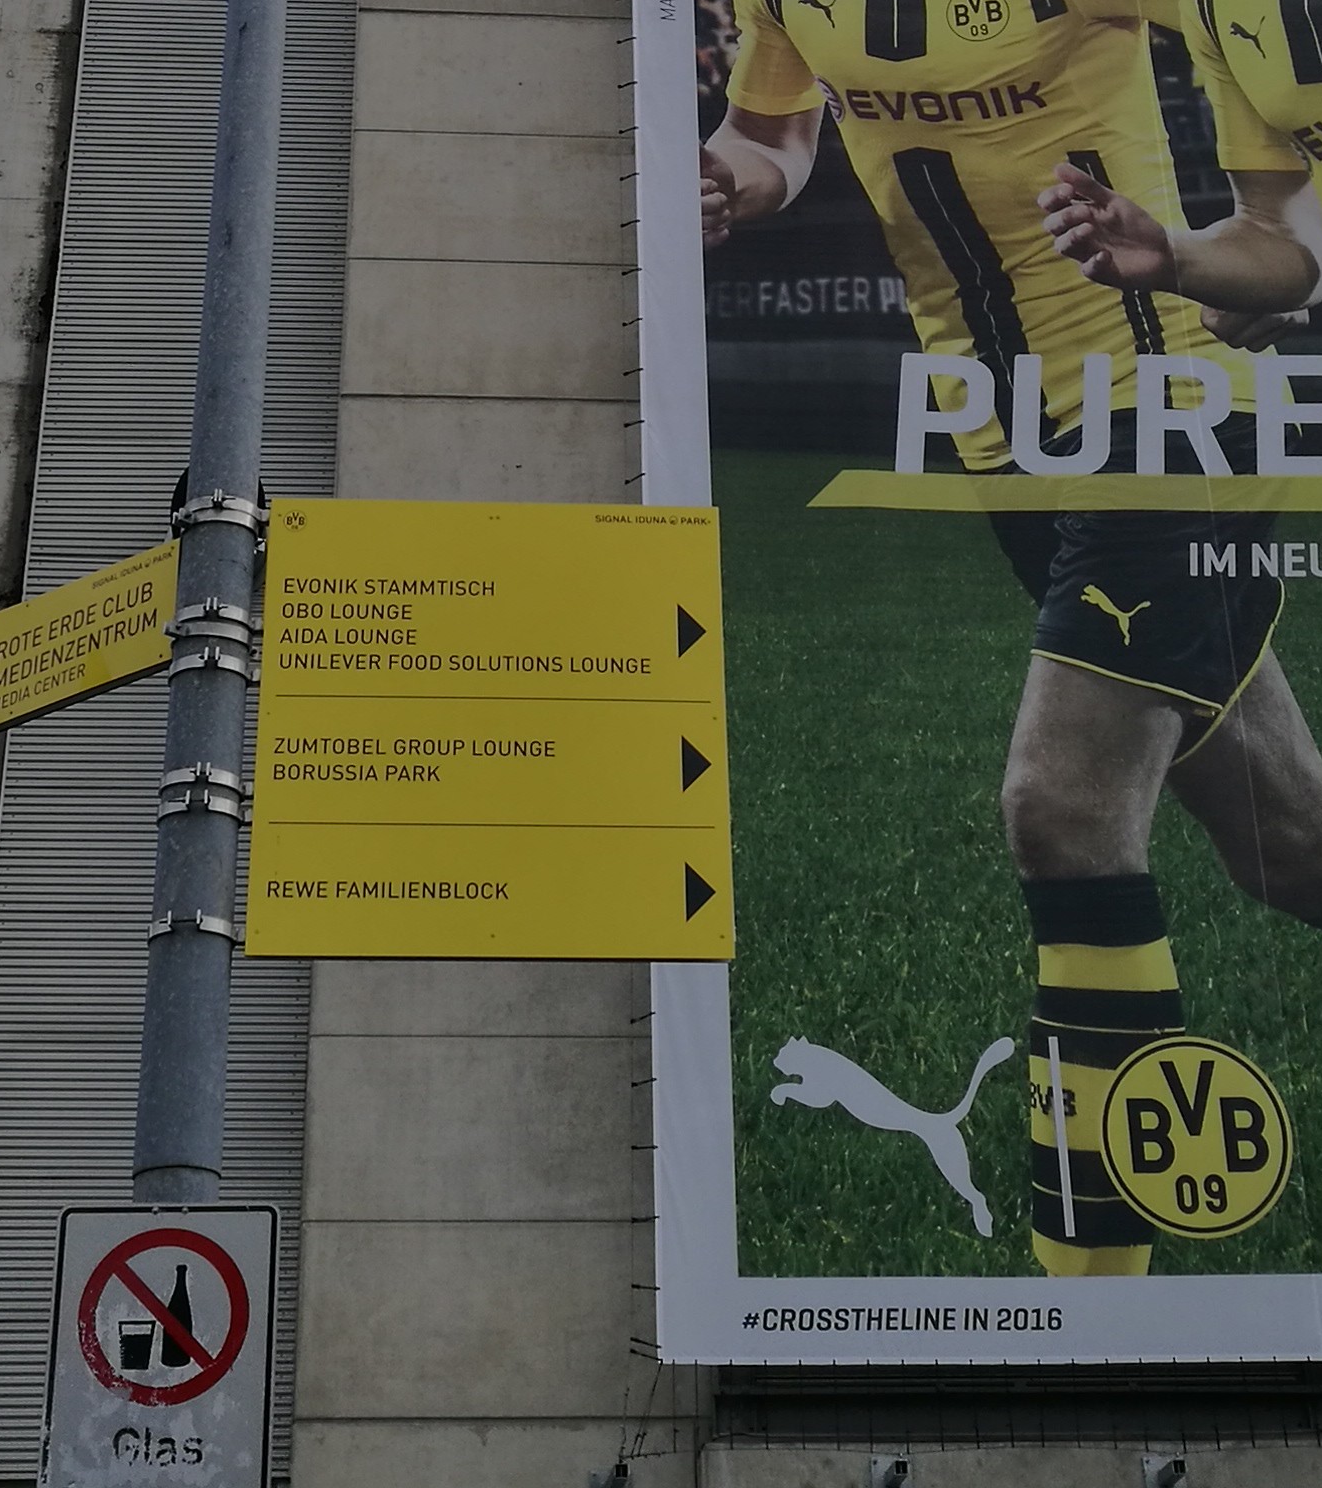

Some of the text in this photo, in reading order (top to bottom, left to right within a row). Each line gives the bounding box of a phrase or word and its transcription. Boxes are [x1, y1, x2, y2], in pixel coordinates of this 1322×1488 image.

[970, 23, 989, 37] 09
[846, 81, 1047, 123] EVONIK
[595, 514, 708, 526] SIGNAL IDUNA PARK
[1188, 541, 1237, 577] IM
[283, 577, 496, 597] EVONIK STAMMTISCH
[48, 603, 97, 641] ERDE
[102, 581, 154, 618] CLUB
[281, 602, 413, 621] OBO LOUNGE
[279, 627, 417, 645] AIDA LOUNGE
[279, 653, 651, 675] UNILEVER FOOD SOLUTIONS LOUNGE
[33, 664, 86, 695] CENTER
[273, 737, 556, 758] ZUMTOBEL GROUP LOUNGE
[272, 763, 441, 783] BORUSSIA PARK
[267, 880, 509, 900] REWE FAMILIENBLOCK
[1125, 1060, 1270, 1174] BVB
[1174, 1173, 1228, 1214] 09
[742, 1307, 1064, 1332] #CROSSTHELINE IN 2016
[112, 1427, 205, 1466] Glas
